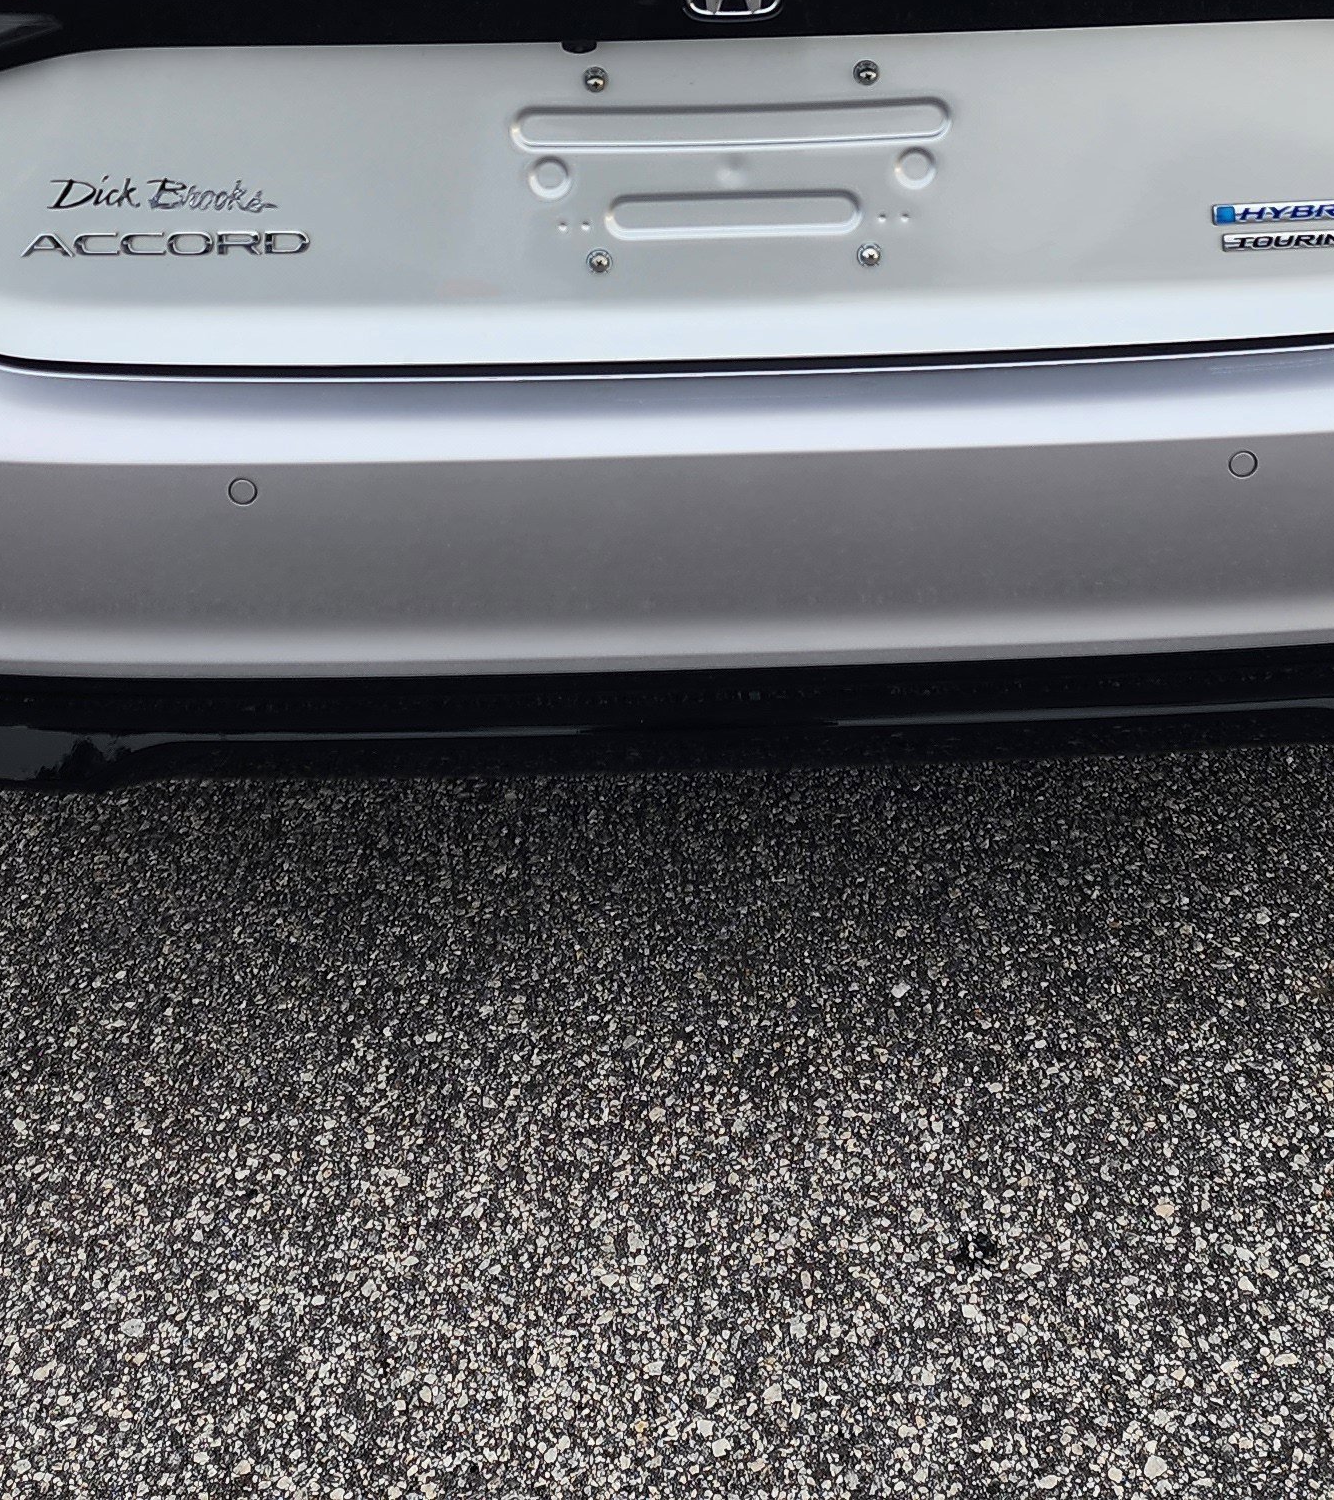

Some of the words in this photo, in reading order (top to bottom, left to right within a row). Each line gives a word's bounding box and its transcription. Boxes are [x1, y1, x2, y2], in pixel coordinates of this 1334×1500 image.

[47, 175, 141, 210] Dick
[146, 177, 279, 214] Brooks
[20, 231, 311, 258] ACCORD
